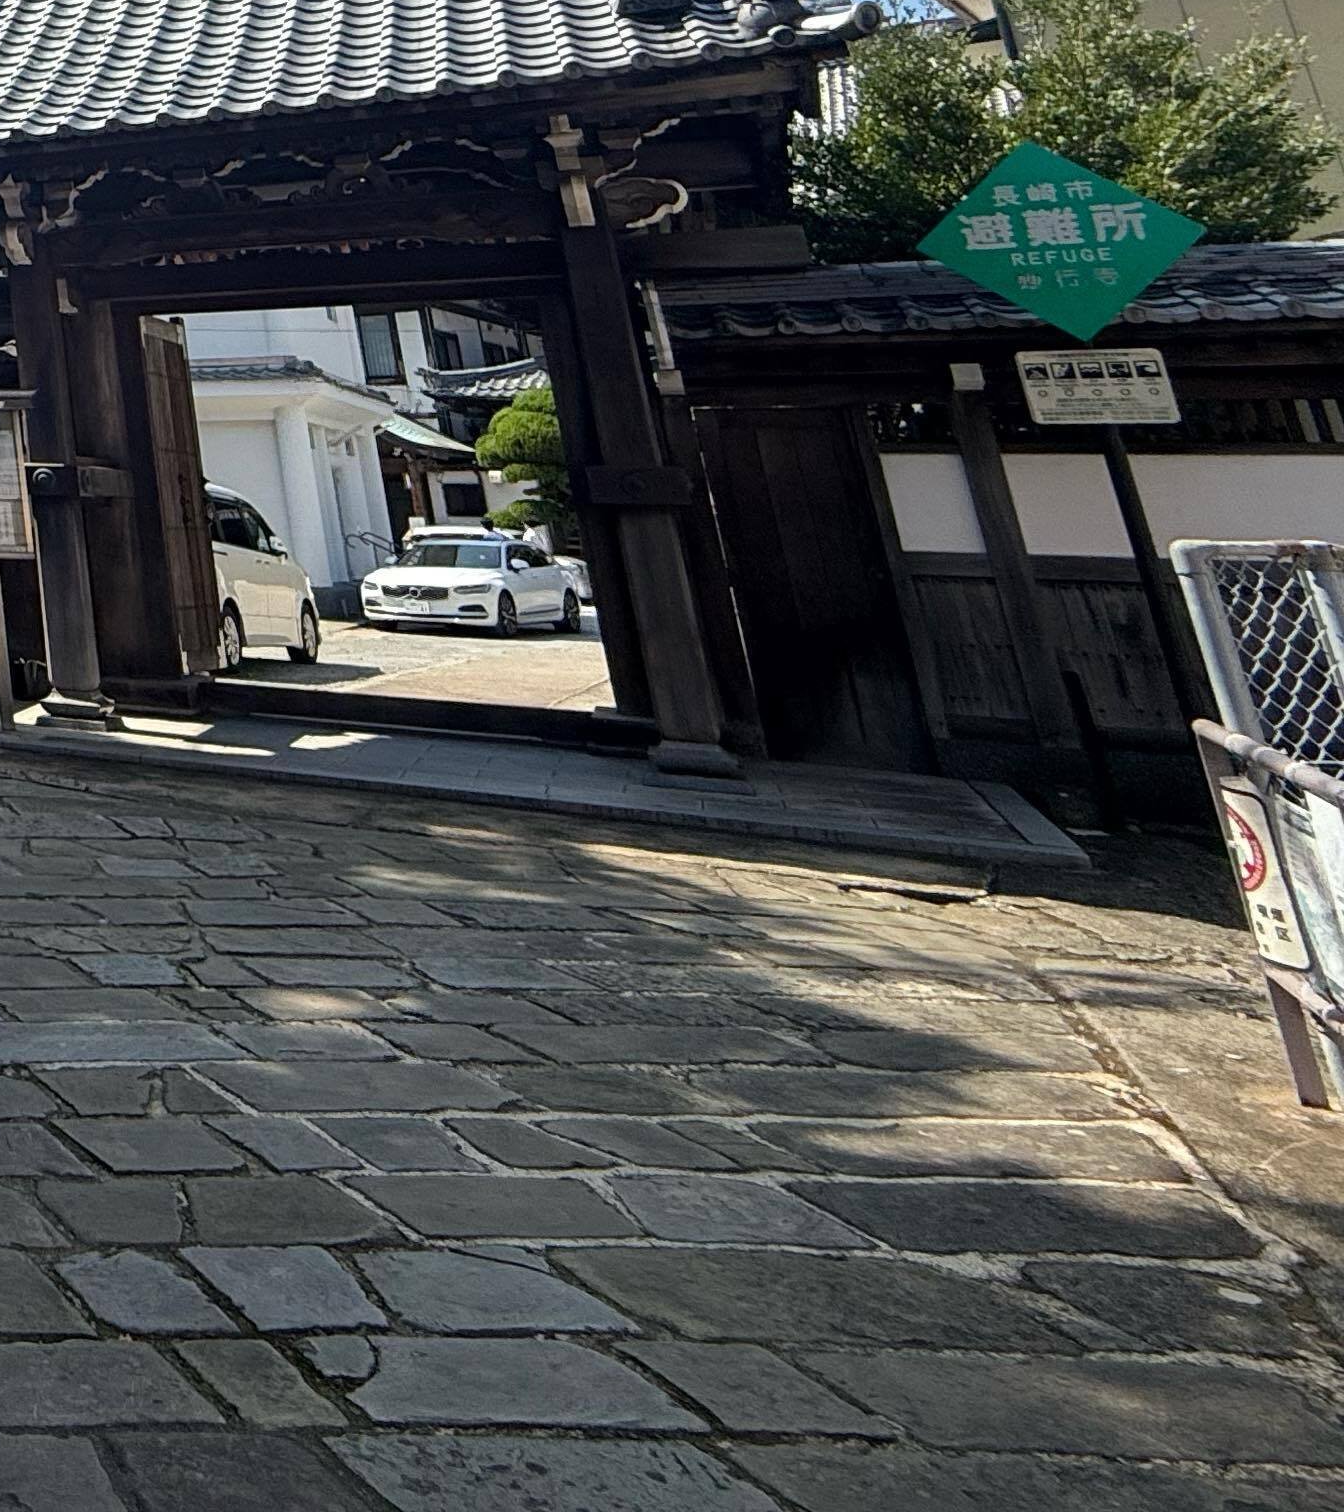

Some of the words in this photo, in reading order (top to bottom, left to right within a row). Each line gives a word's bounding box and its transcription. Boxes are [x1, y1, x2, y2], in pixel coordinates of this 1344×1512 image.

[992, 180, 1094, 207] 長崎市
[958, 201, 1147, 250] 避難所
[1009, 247, 1115, 267] REFUGE
